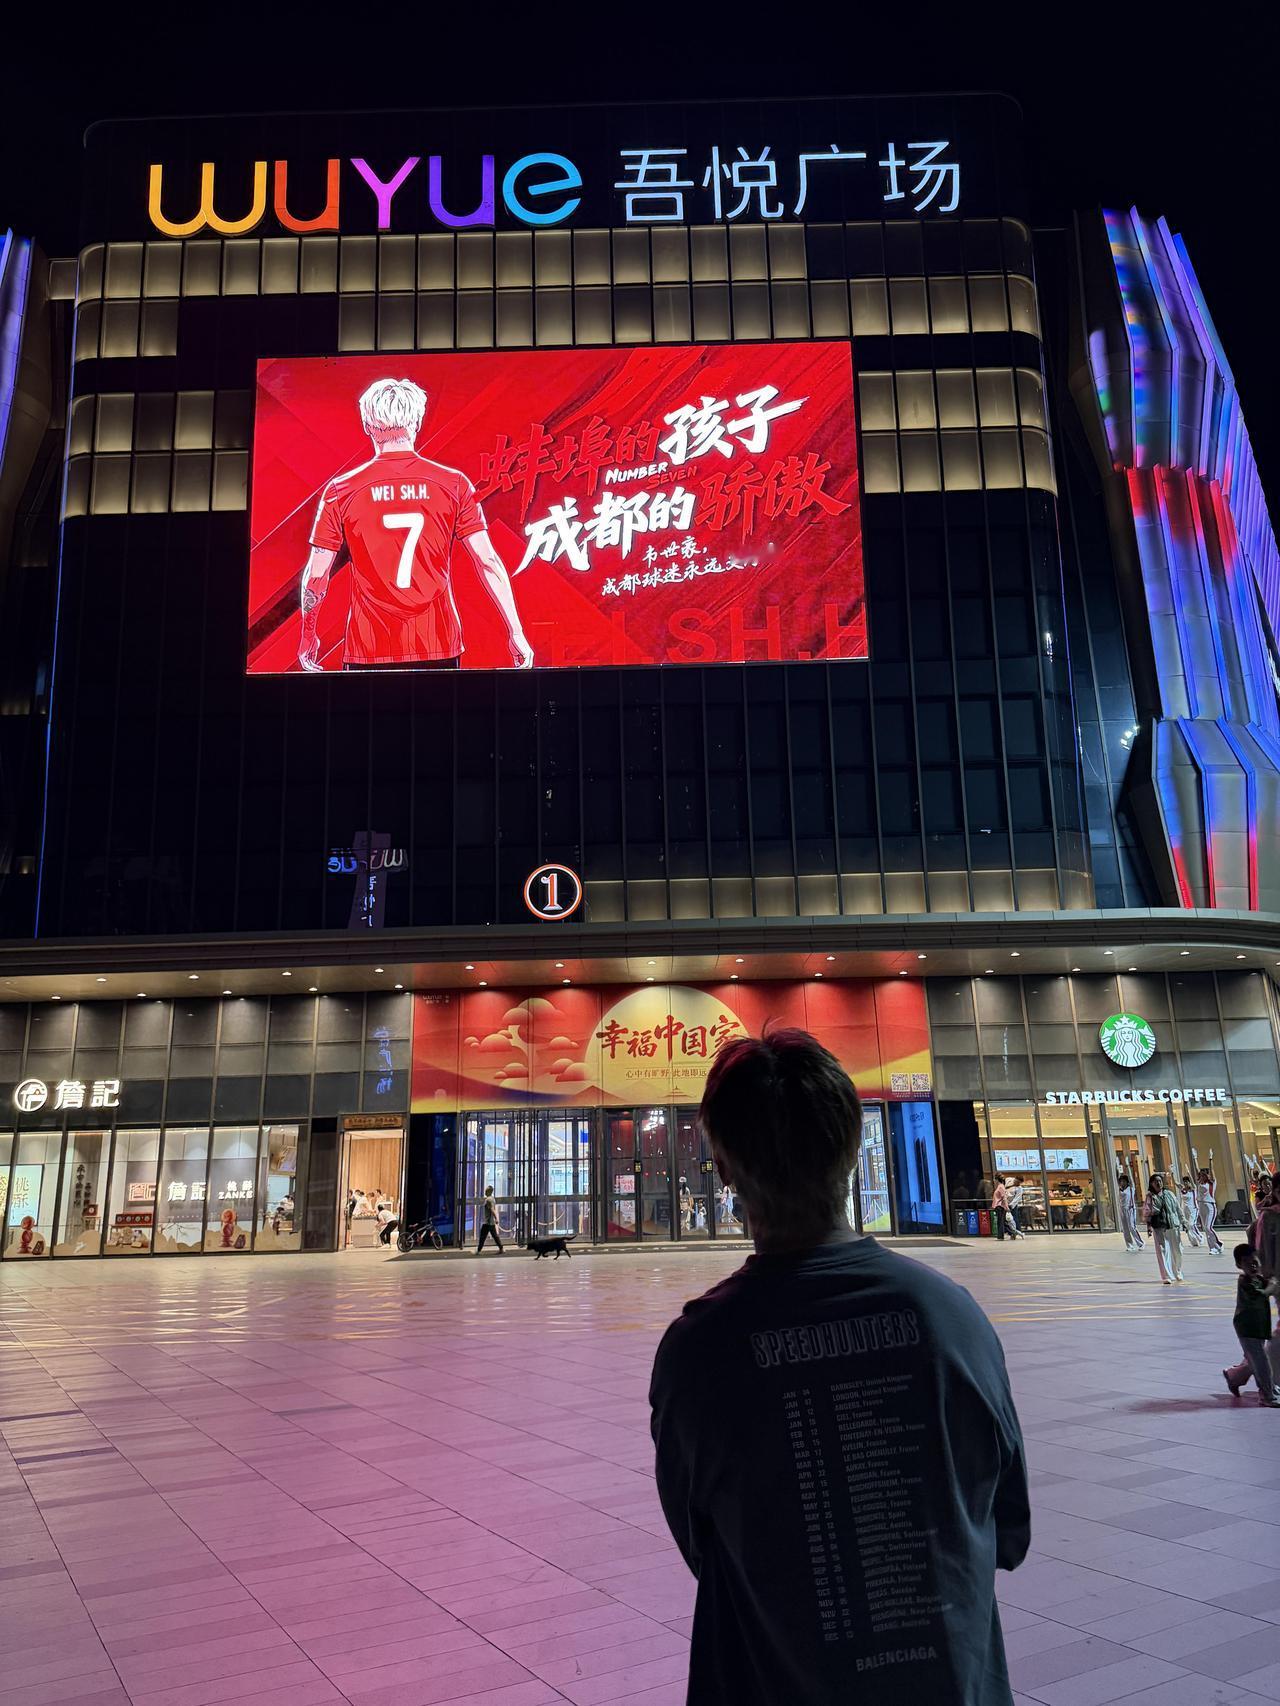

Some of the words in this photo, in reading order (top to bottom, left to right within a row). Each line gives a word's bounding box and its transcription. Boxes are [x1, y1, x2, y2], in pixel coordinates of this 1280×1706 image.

[614, 141, 961, 221] 吾悦广场
[476, 384, 810, 524] 蚌埠的孩子
[605, 462, 669, 485] NUMBER
[371, 486, 394, 501] WEI
[400, 484, 430, 500] SH.H.
[645, 466, 698, 489] SEVEN
[511, 453, 851, 577] 成都的骄傲
[383, 512, 425, 589] 7
[596, 1014, 740, 1062] 幸福中国家
[54, 1079, 120, 1110] 詹記
[1046, 1089, 1154, 1105] STARBUCKS
[1158, 1088, 1226, 1103] COFFEE
[751, 1309, 920, 1368] SPEEDHUNTERS
[854, 1643, 937, 1671] BALENCIAGA
